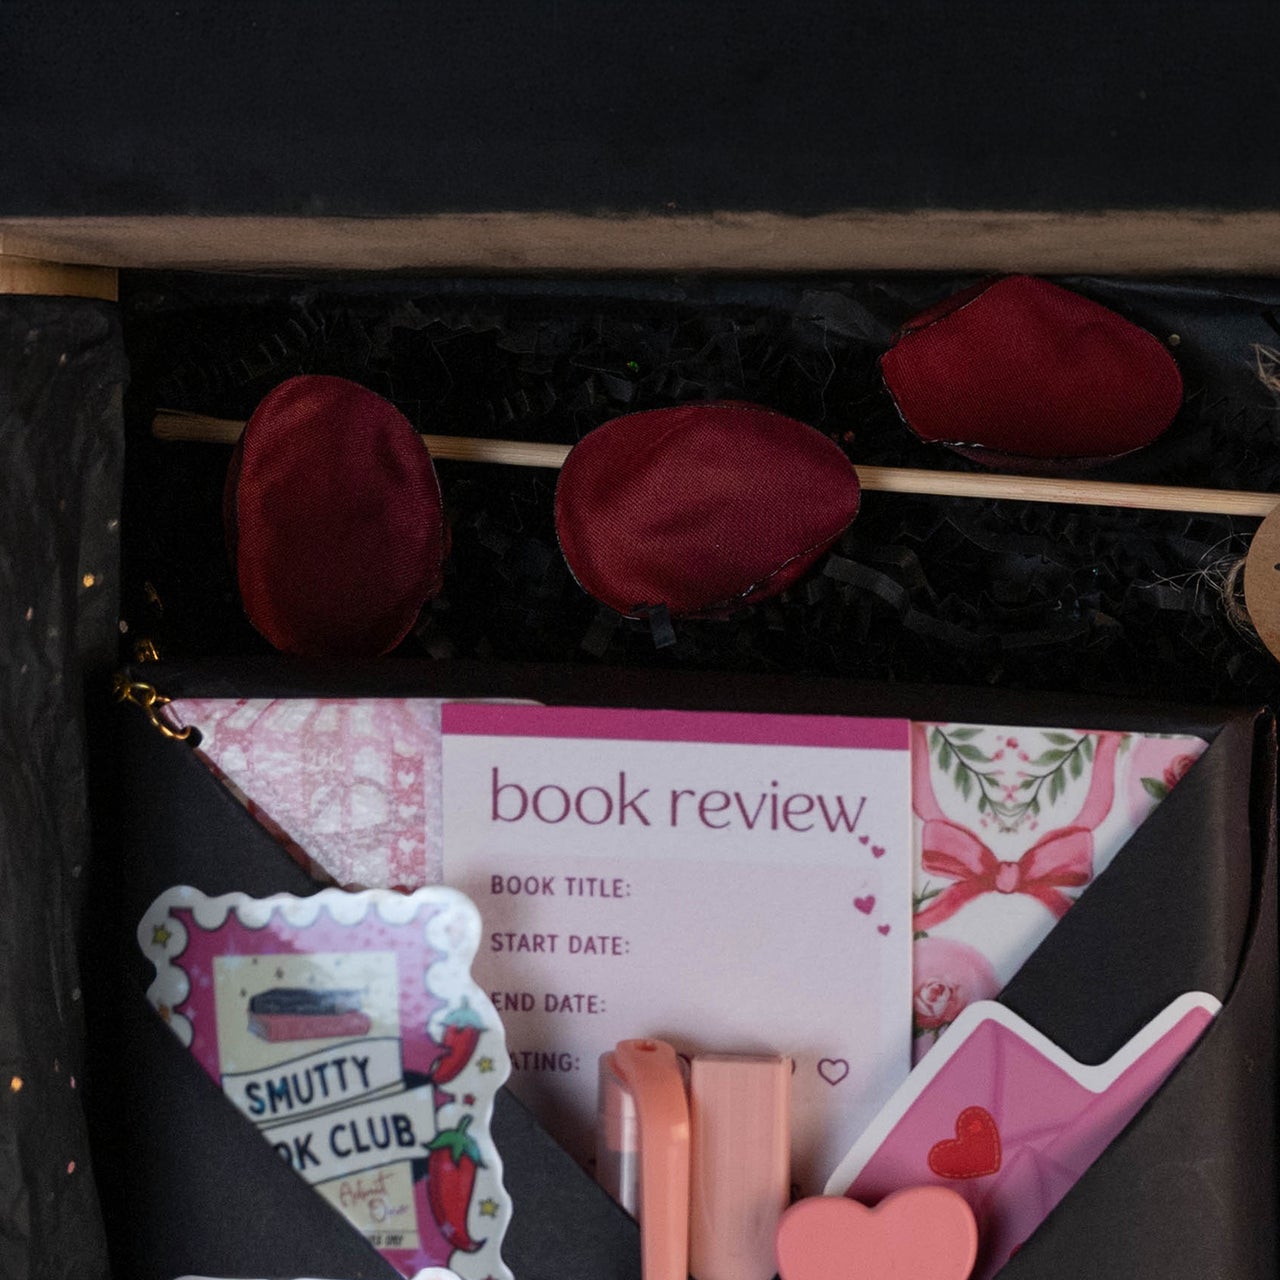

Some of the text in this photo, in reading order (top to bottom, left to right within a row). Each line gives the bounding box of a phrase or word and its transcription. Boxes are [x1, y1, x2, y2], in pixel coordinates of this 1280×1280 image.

[491, 766, 867, 833] book review
[491, 875, 631, 897] BOOK TITLE:
[491, 933, 630, 955] START DATE:
[491, 991, 606, 1014] END DATE:
[245, 1056, 369, 1114] SMUTTY
[329, 1113, 415, 1157] CLUB
